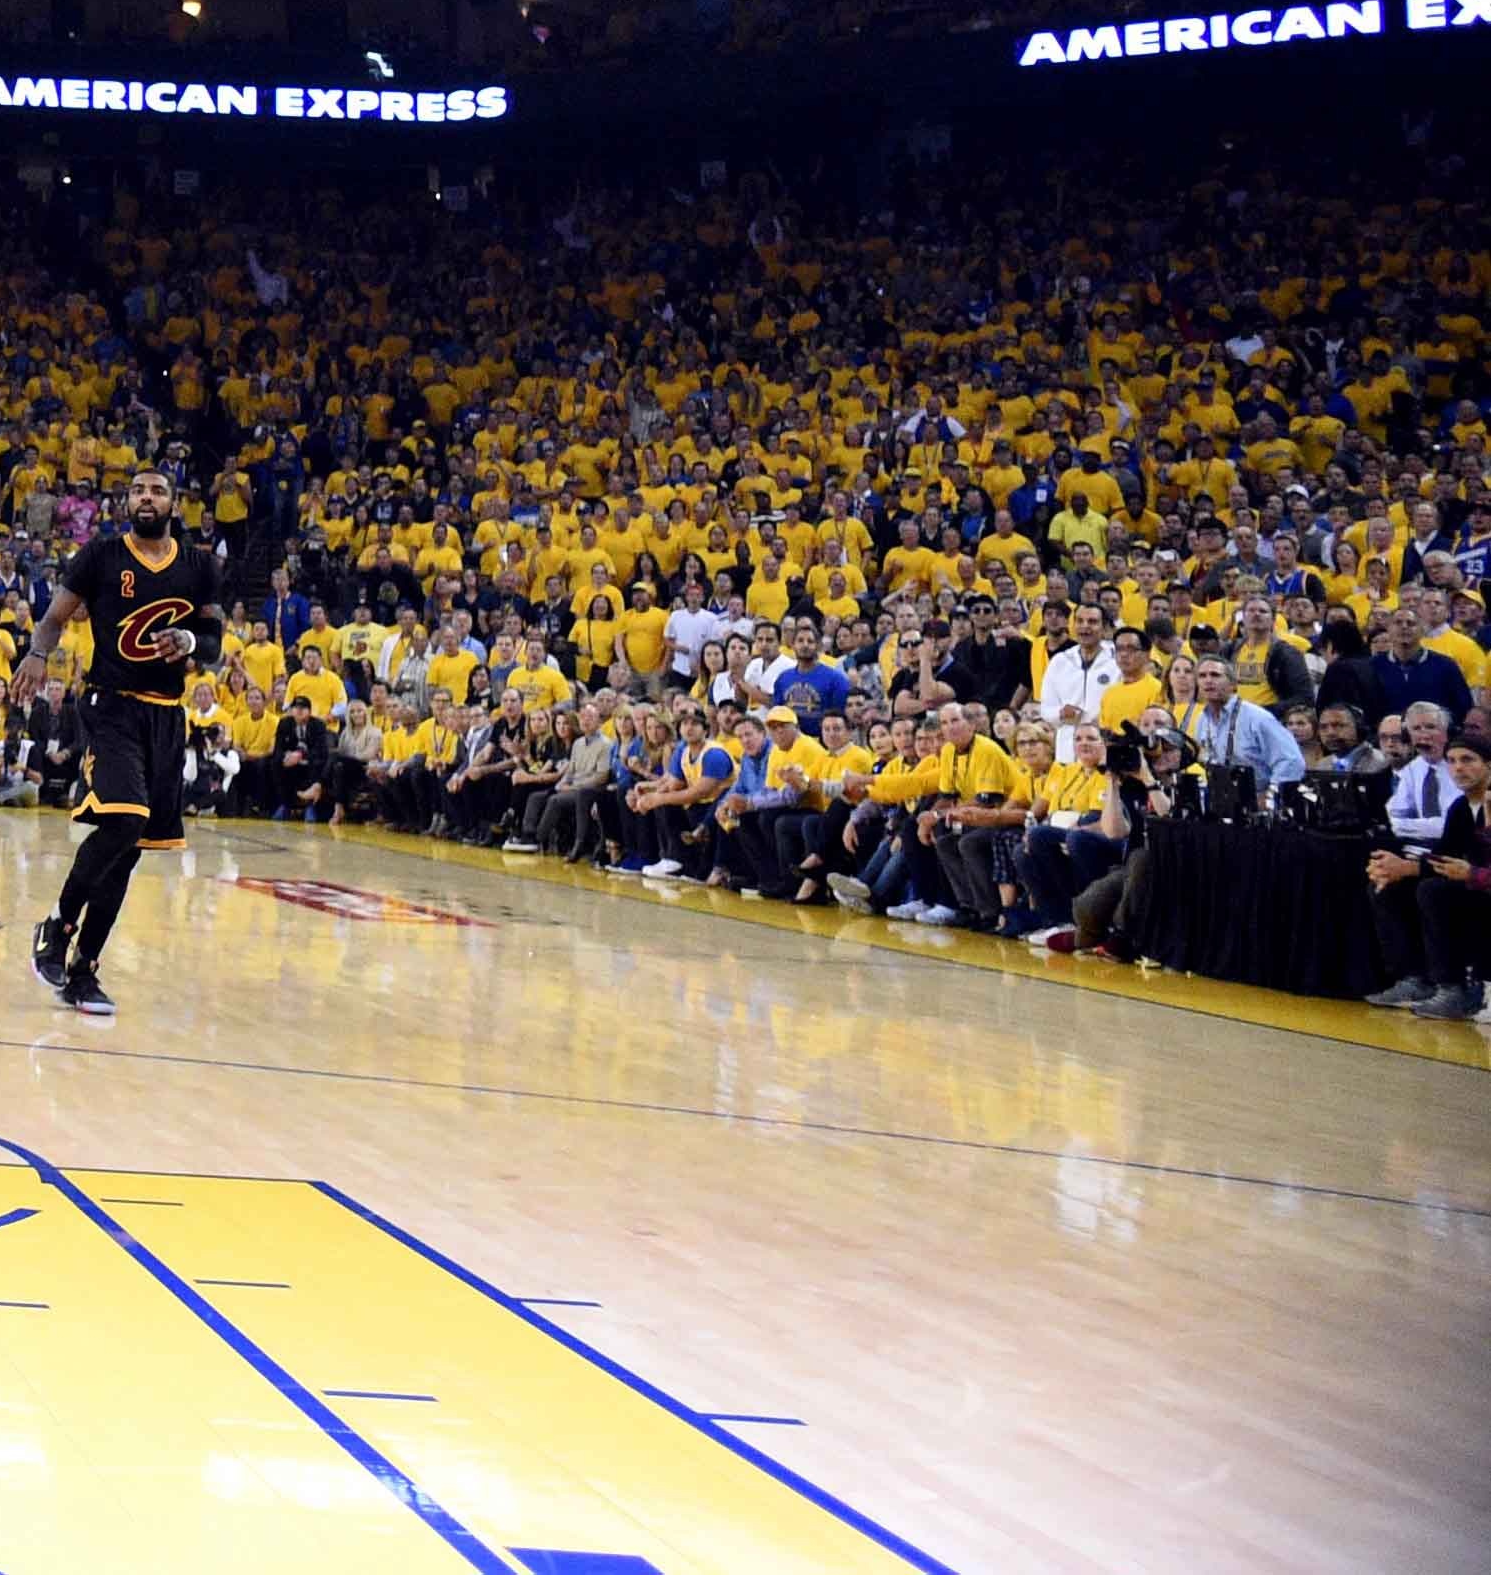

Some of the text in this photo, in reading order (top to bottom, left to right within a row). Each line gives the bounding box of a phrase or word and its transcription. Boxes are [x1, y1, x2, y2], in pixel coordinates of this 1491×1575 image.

[1019, 0, 1381, 66] AMERICAN
[275, 85, 508, 122] EXPRESS
[120, 570, 135, 599] 2
